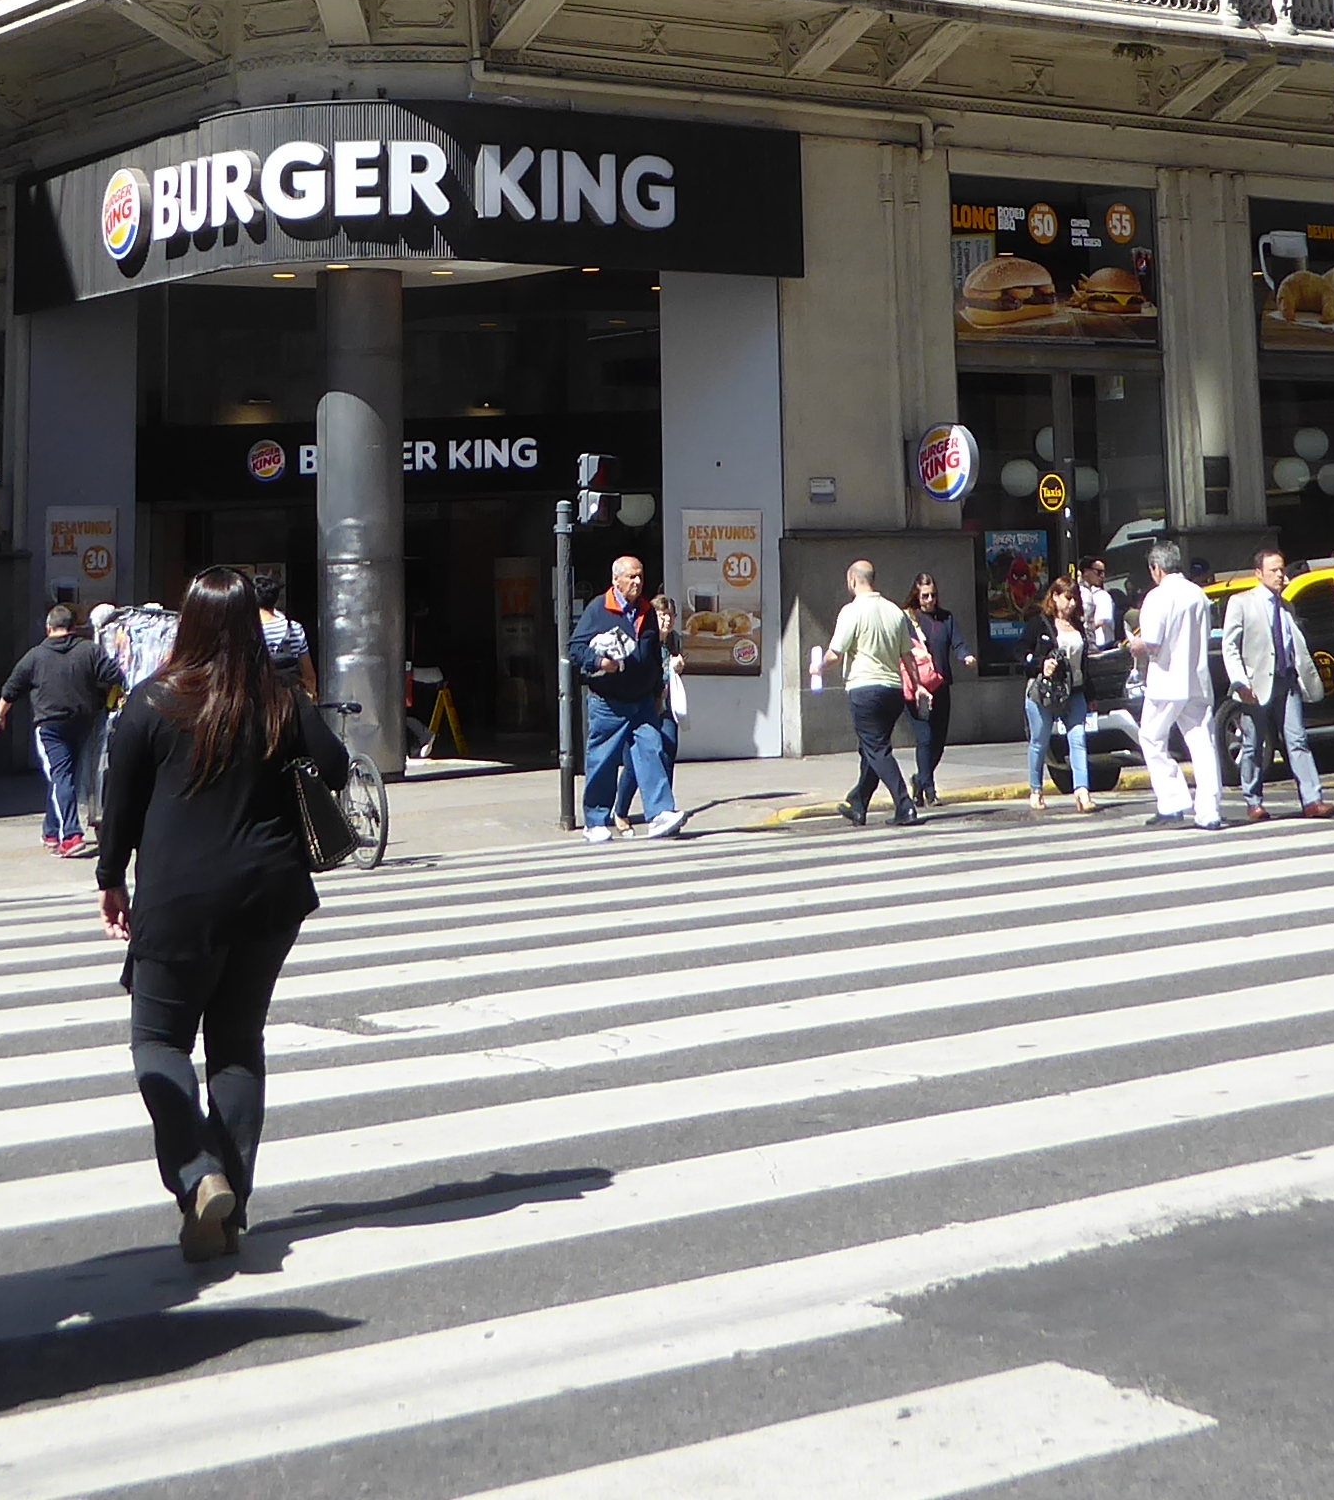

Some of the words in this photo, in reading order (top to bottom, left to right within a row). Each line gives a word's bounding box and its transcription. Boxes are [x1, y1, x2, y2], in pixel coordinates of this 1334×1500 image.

[152, 140, 451, 241] BURGER
[474, 143, 676, 229] KING
[952, 204, 996, 231] LONG
[252, 454, 281, 473] KING
[448, 437, 538, 471] KING
[919, 437, 958, 467] BURGER
[921, 450, 960, 484] KING
[51, 521, 112, 535] DESAYUNOS
[688, 525, 756, 540] DESAYUNOS
[688, 540, 717, 558] A.M.
